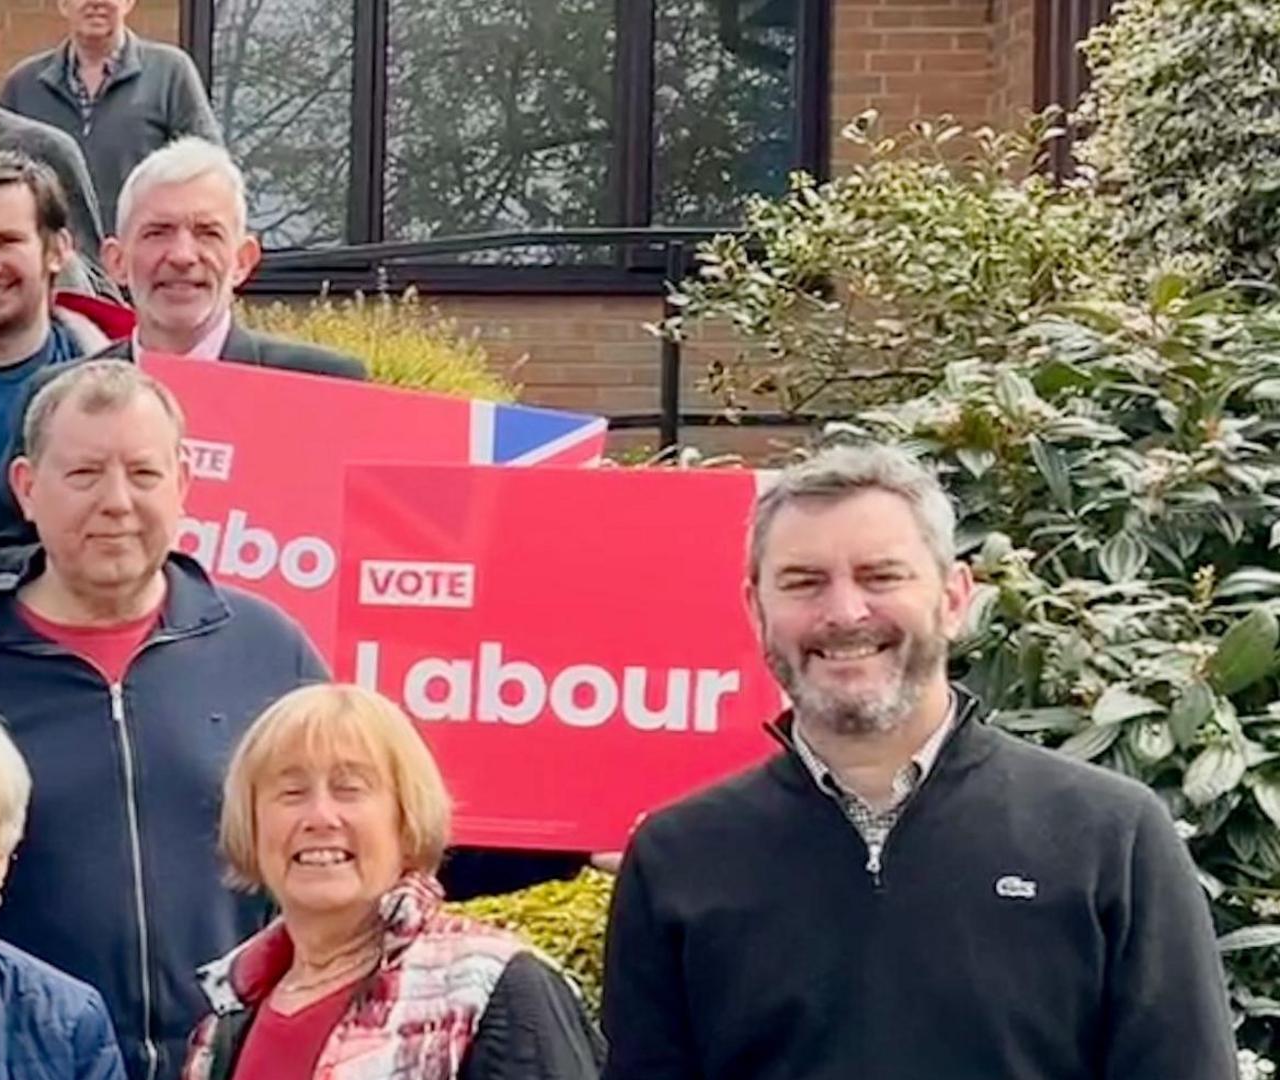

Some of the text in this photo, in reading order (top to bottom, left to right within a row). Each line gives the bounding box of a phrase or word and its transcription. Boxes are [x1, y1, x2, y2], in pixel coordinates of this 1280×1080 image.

[178, 446, 227, 472] TE
[175, 509, 337, 589] abo
[367, 568, 468, 600] VOTE
